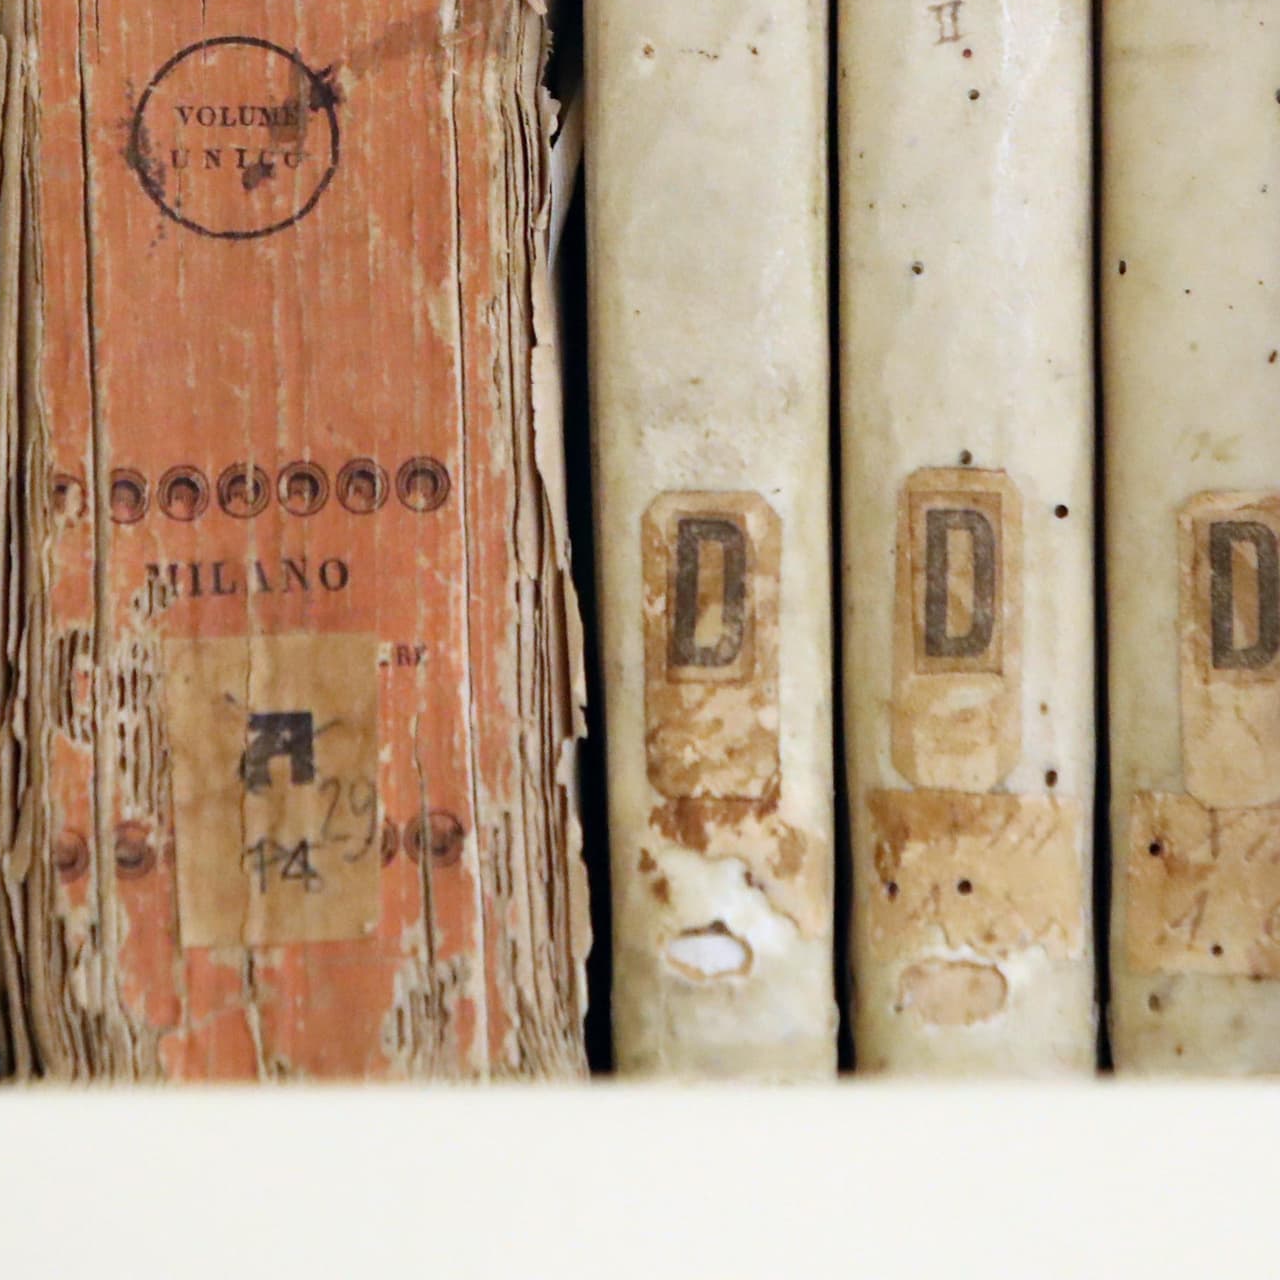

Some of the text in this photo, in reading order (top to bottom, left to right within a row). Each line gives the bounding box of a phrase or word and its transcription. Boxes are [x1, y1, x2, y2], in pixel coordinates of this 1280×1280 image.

[174, 105, 300, 128] VOLUME
[145, 557, 350, 599] MILANO
[674, 517, 747, 670] D
[924, 506, 997, 658] D
